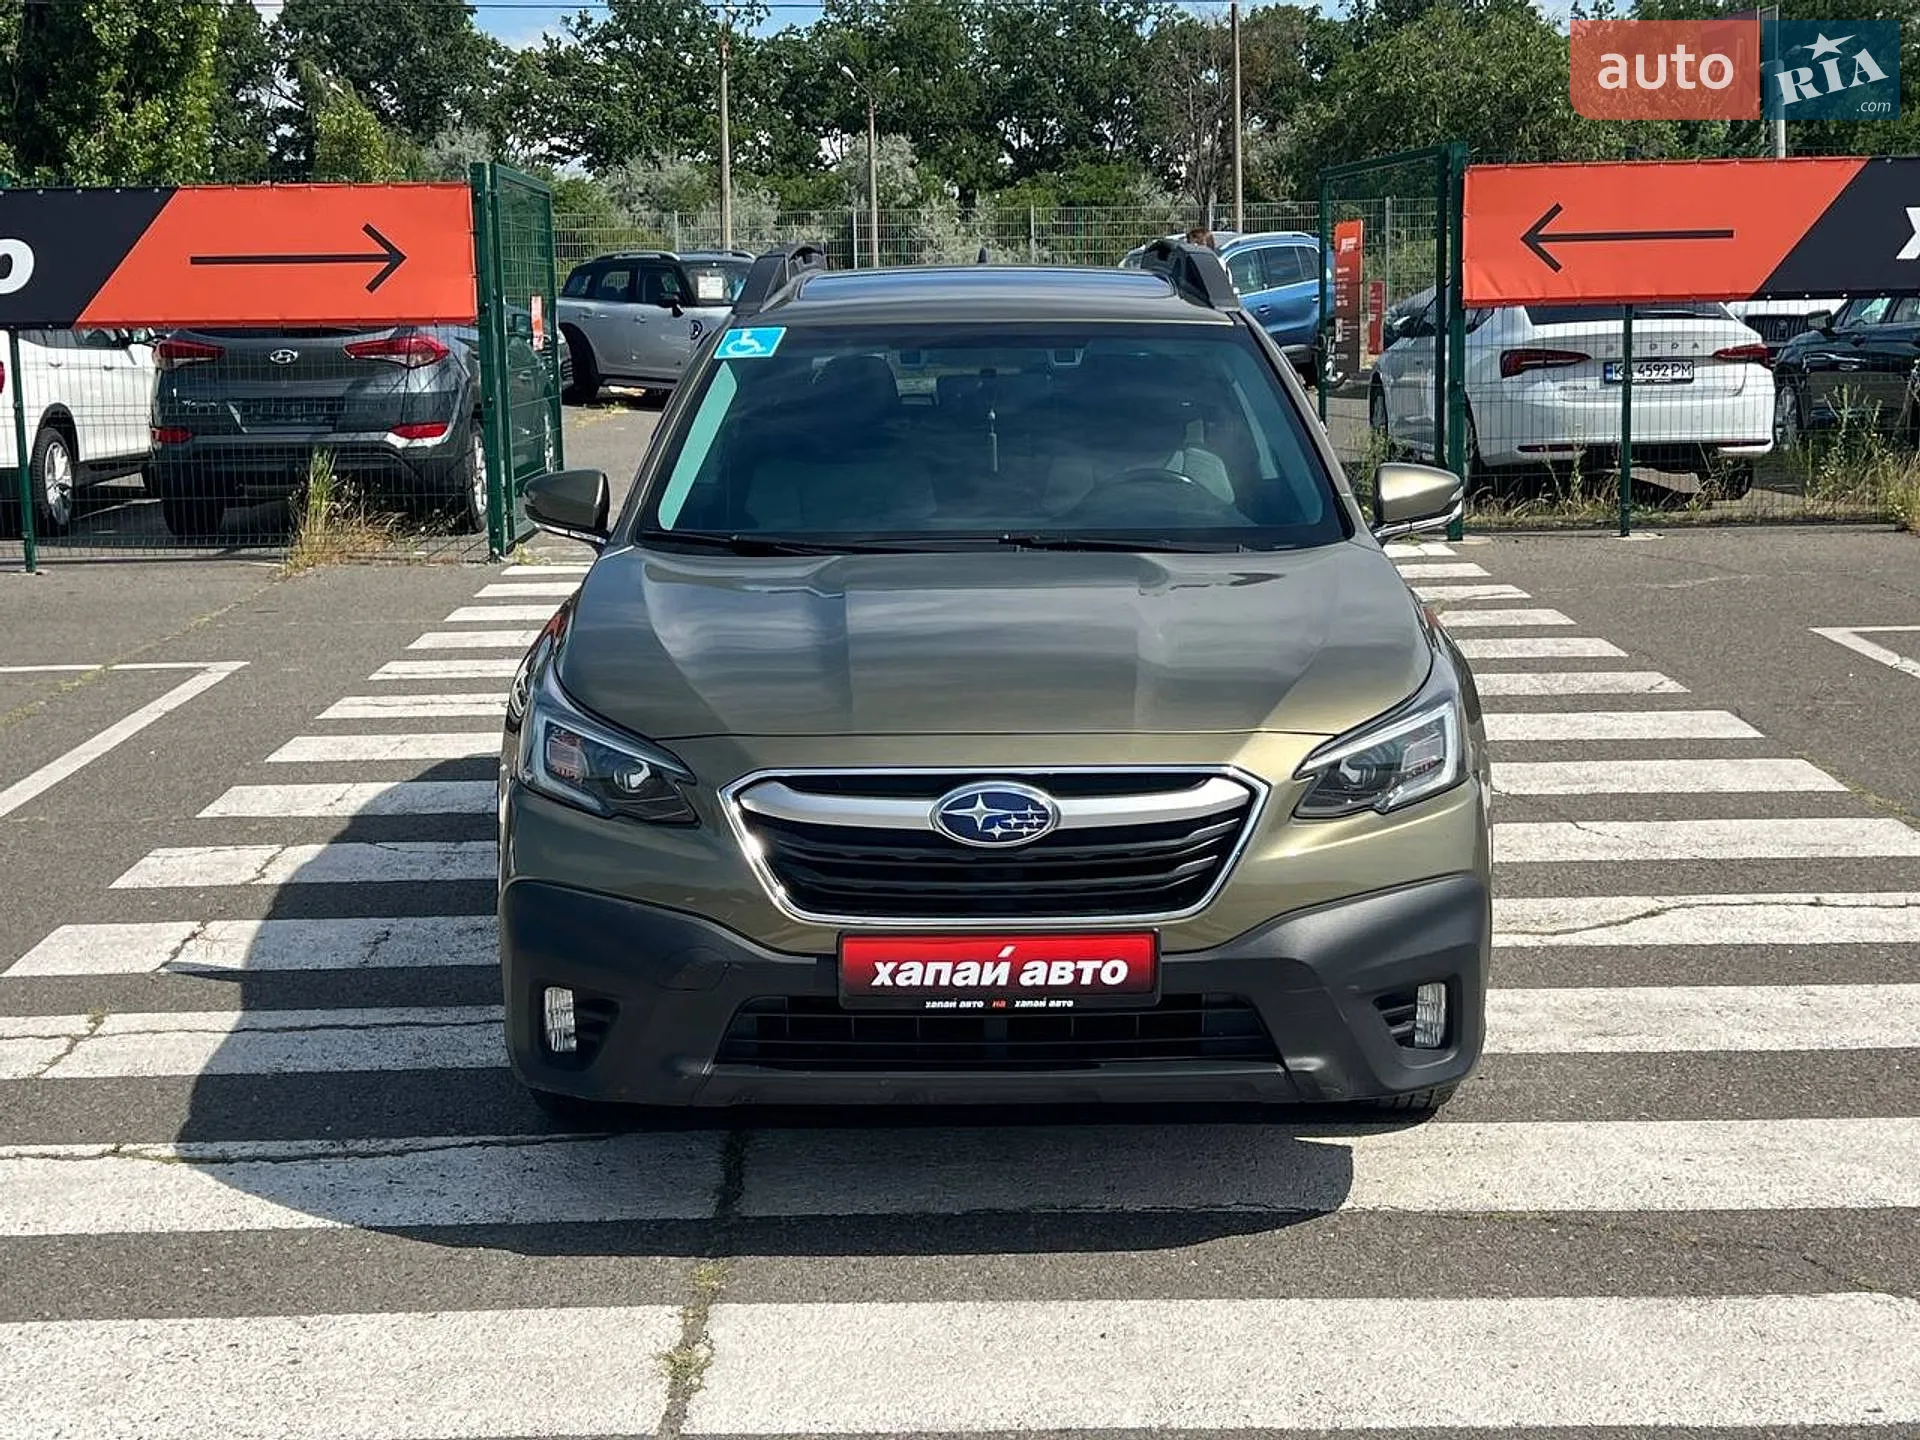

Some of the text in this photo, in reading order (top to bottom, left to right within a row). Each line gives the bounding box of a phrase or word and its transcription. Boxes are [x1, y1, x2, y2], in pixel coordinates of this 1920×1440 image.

[1638, 363, 1669, 377] 4592
[871, 946, 1129, 987] хапай авто
